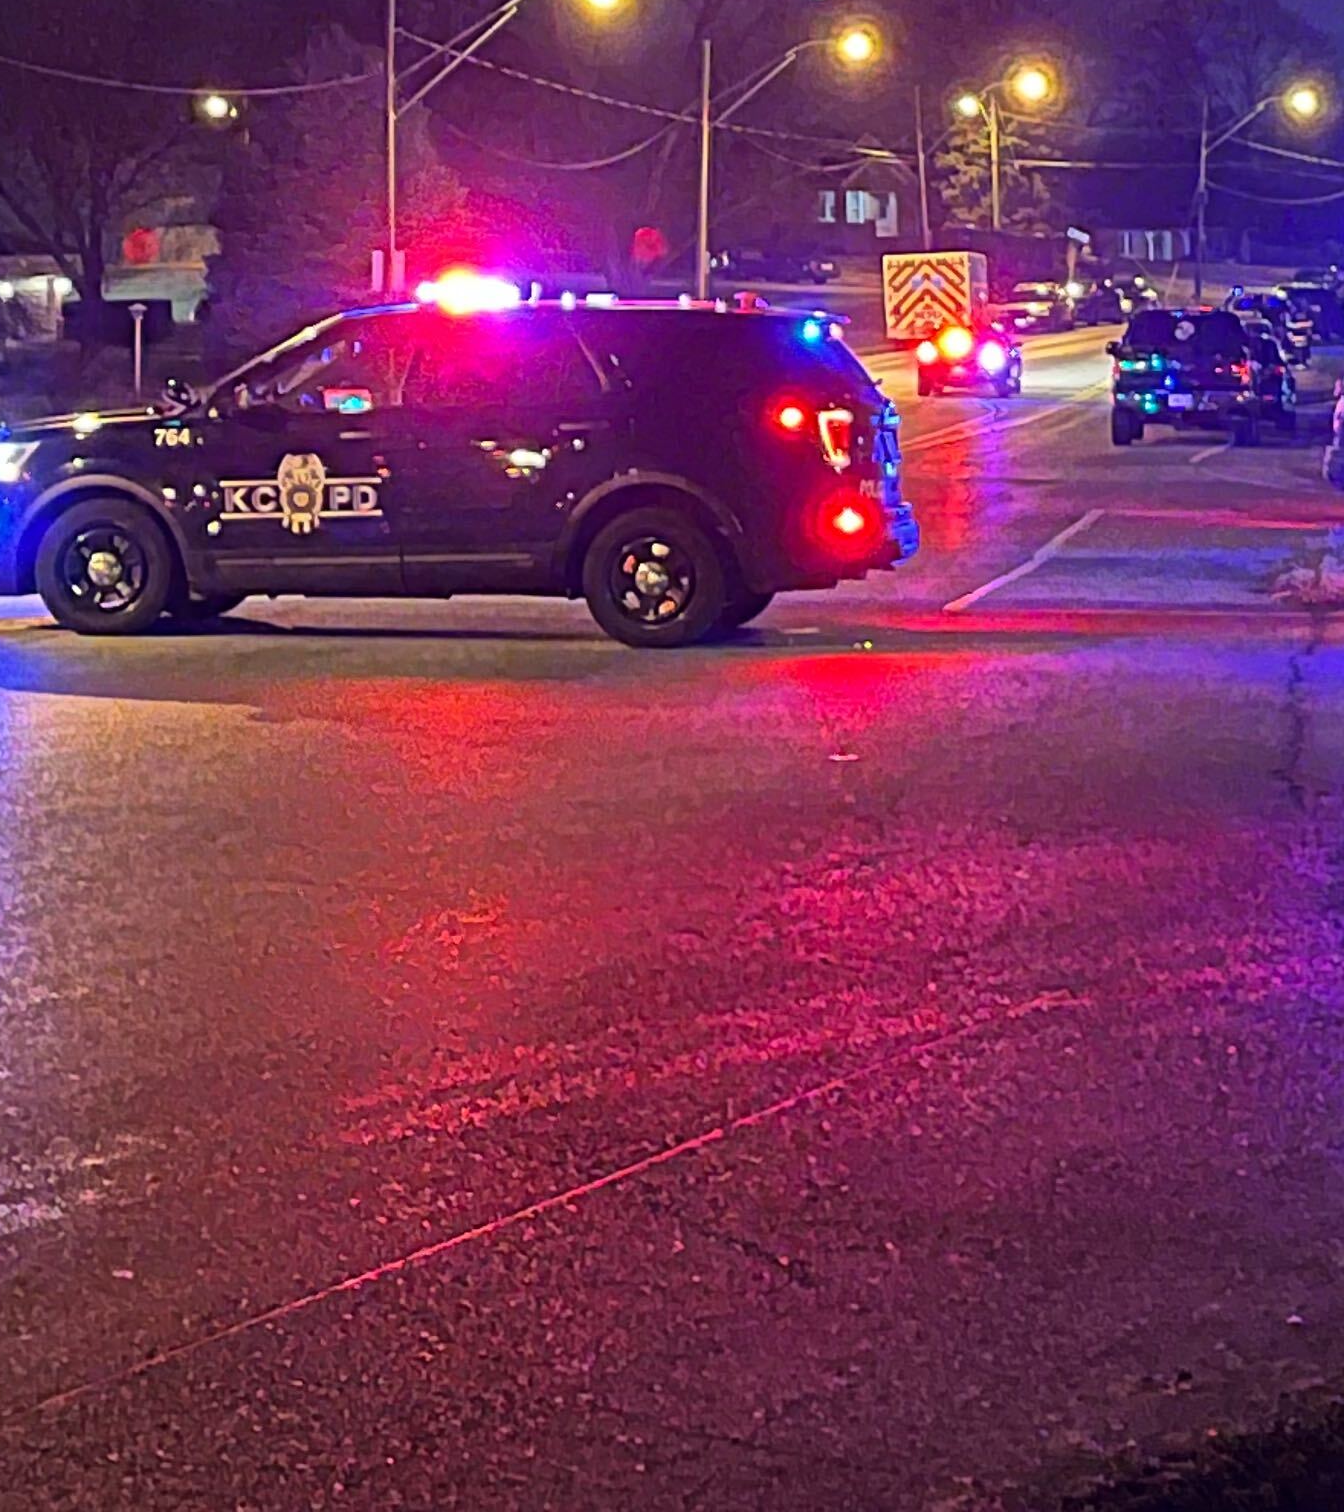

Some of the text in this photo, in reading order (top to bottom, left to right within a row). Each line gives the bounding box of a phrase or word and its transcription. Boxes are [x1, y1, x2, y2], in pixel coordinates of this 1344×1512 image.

[154, 428, 190, 447] 764
[224, 485, 378, 513] KC PD
